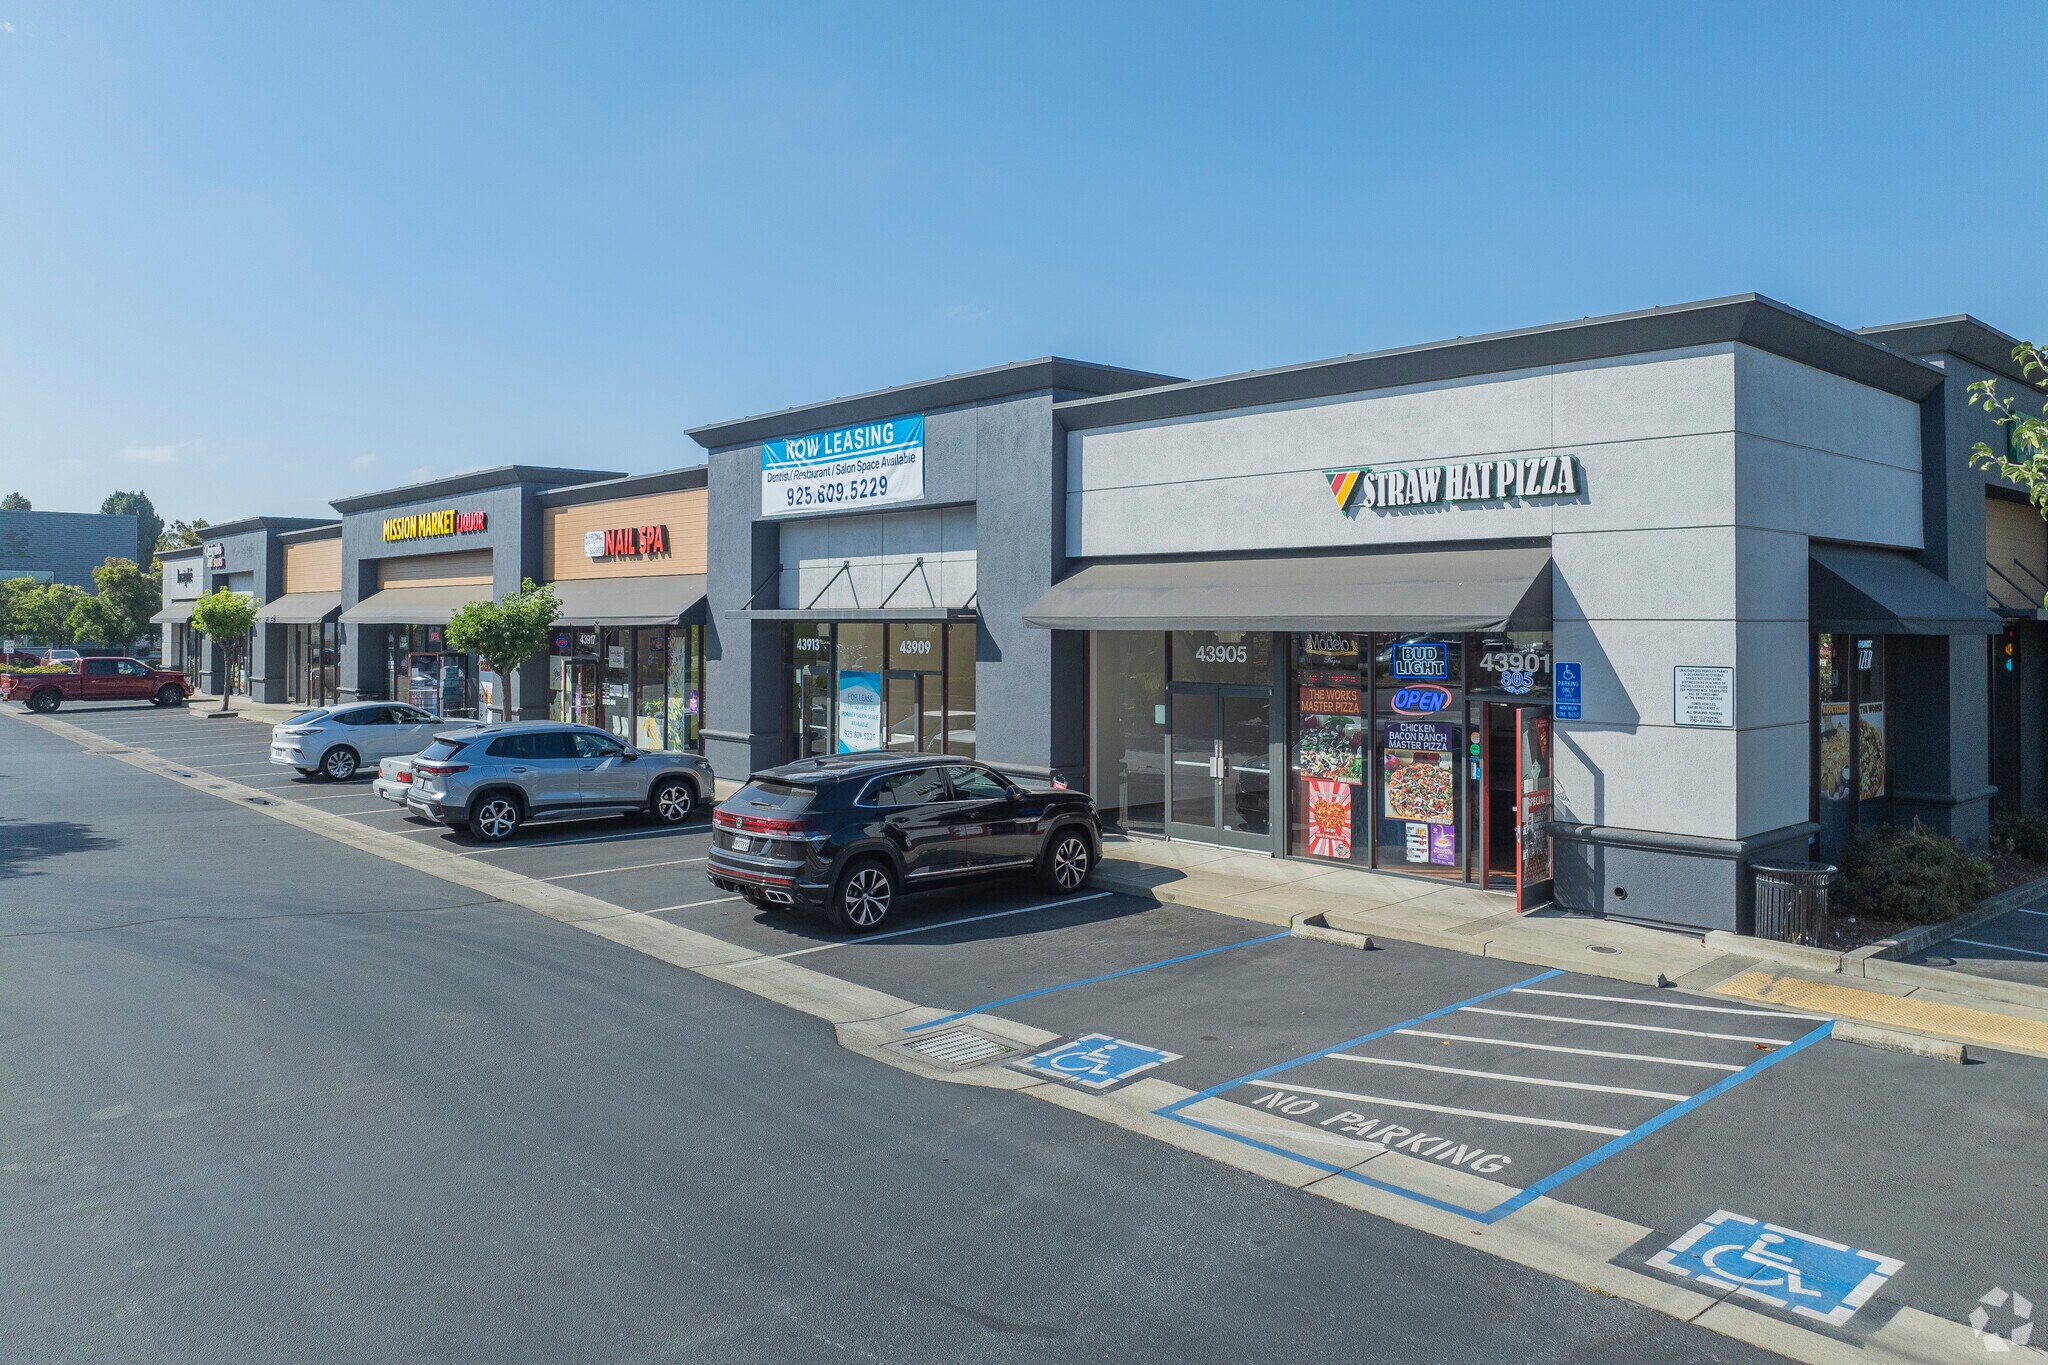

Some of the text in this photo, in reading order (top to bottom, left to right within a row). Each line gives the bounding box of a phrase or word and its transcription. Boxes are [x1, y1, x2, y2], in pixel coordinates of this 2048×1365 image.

[786, 422, 894, 460] NOW LEASING
[767, 471, 790, 483] Dentist
[794, 466, 831, 480] Restaurant
[836, 463, 856, 476] Salon
[857, 460, 880, 474] Space
[881, 452, 916, 468] Available
[1363, 455, 1576, 508] STRAW HAT PIZZA
[383, 509, 455, 541] MISSION MARKET
[456, 511, 485, 534] LIQUOR
[605, 527, 635, 556] NAIL
[639, 524, 664, 554] SPA
[580, 635, 596, 645] 43917
[796, 638, 820, 651] 43913
[900, 640, 931, 654] 43909
[1308, 634, 1349, 651] Modelo
[1195, 645, 1247, 663] 43905
[1402, 646, 1437, 661] BUD
[1396, 661, 1445, 675] LIGHT
[1480, 653, 1550, 673] 43901
[1501, 671, 1534, 687] 805
[847, 693, 873, 702] FOR LEASE
[1309, 689, 1357, 701] THE WORKS
[1395, 689, 1445, 712] OPEN
[1301, 701, 1359, 713] MASTER PIZZA
[1400, 723, 1435, 733] CHICKEN
[1389, 731, 1447, 743] BACON RANCH
[1388, 740, 1448, 751] MASTER PIZZA
[1251, 1091, 1512, 1173] NO PARKING
